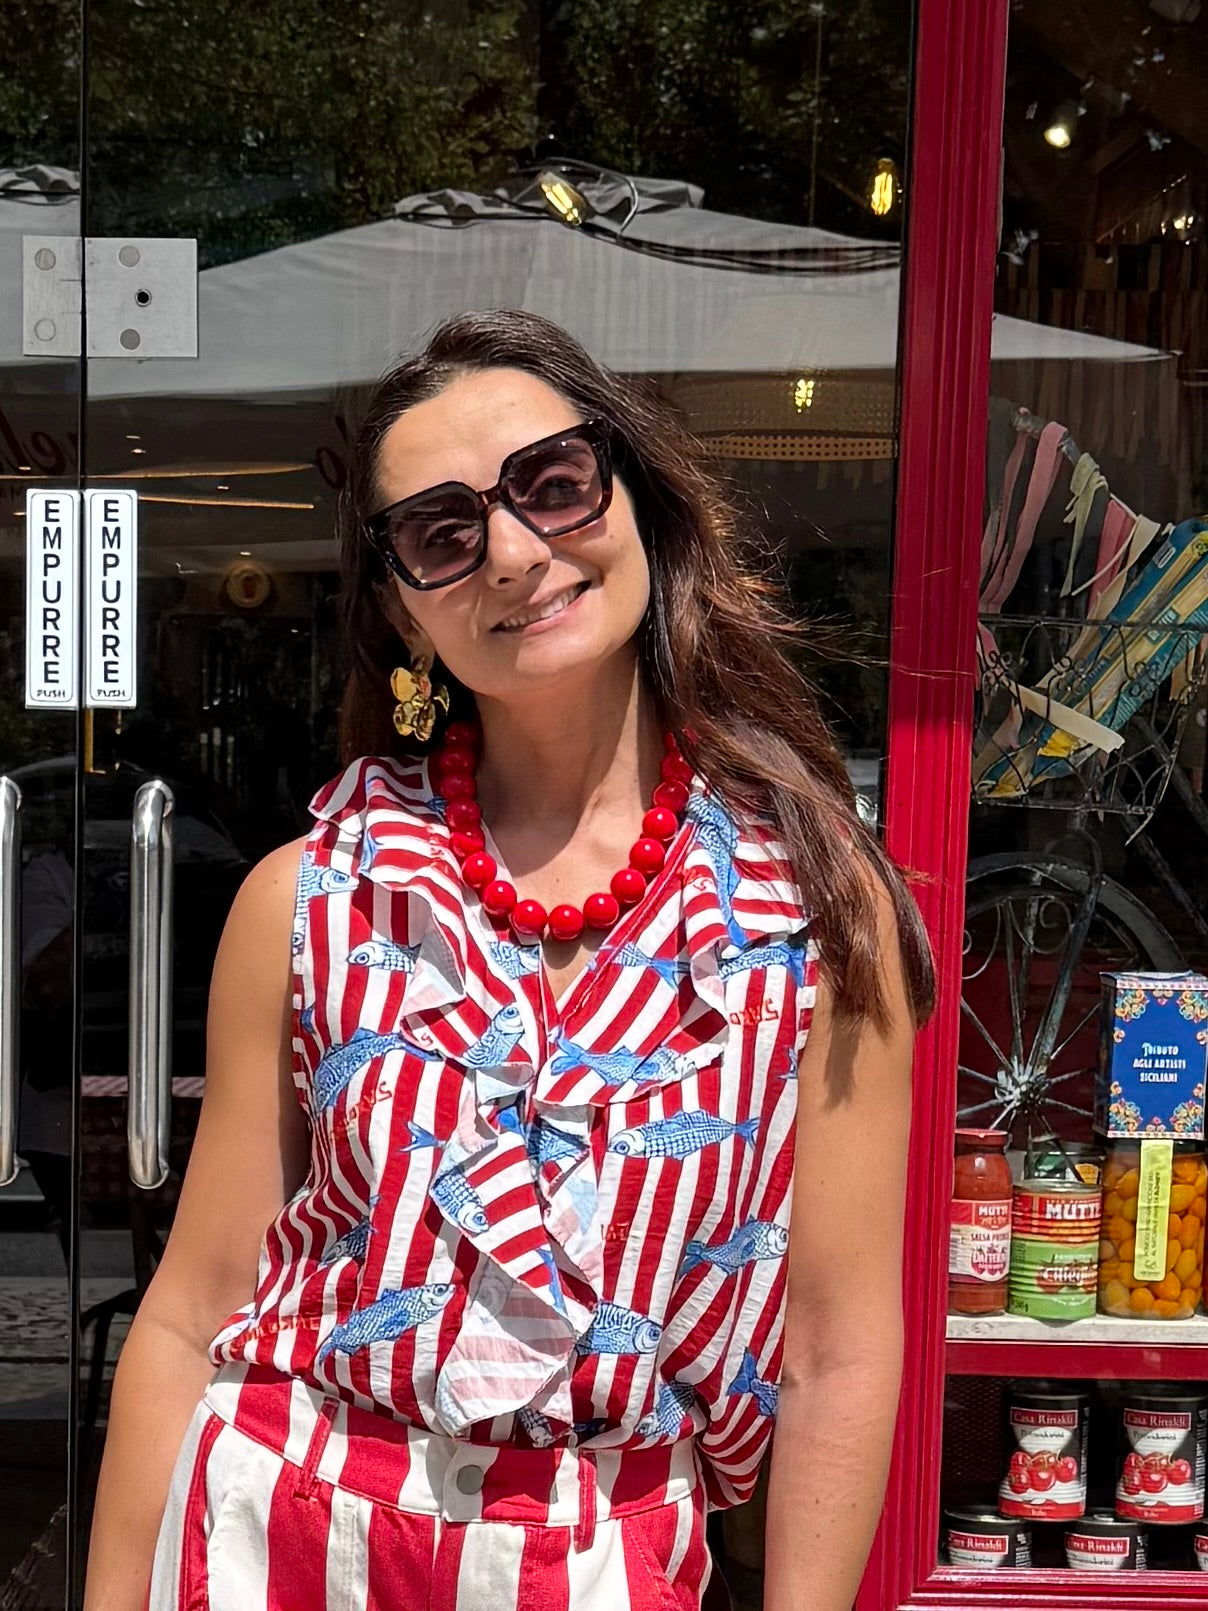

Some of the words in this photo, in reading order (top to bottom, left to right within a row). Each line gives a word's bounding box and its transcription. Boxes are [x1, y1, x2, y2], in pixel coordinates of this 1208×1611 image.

[42, 499, 62, 684] EMPURRE
[101, 499, 122, 684] EMPURRE
[36, 689, 66, 698] PUSH
[96, 689, 126, 697] PUSH
[1132, 1058, 1153, 1069] AGLI
[1154, 1058, 1187, 1070] ARTISTI
[1139, 1072, 1178, 1083] SICILIANI
